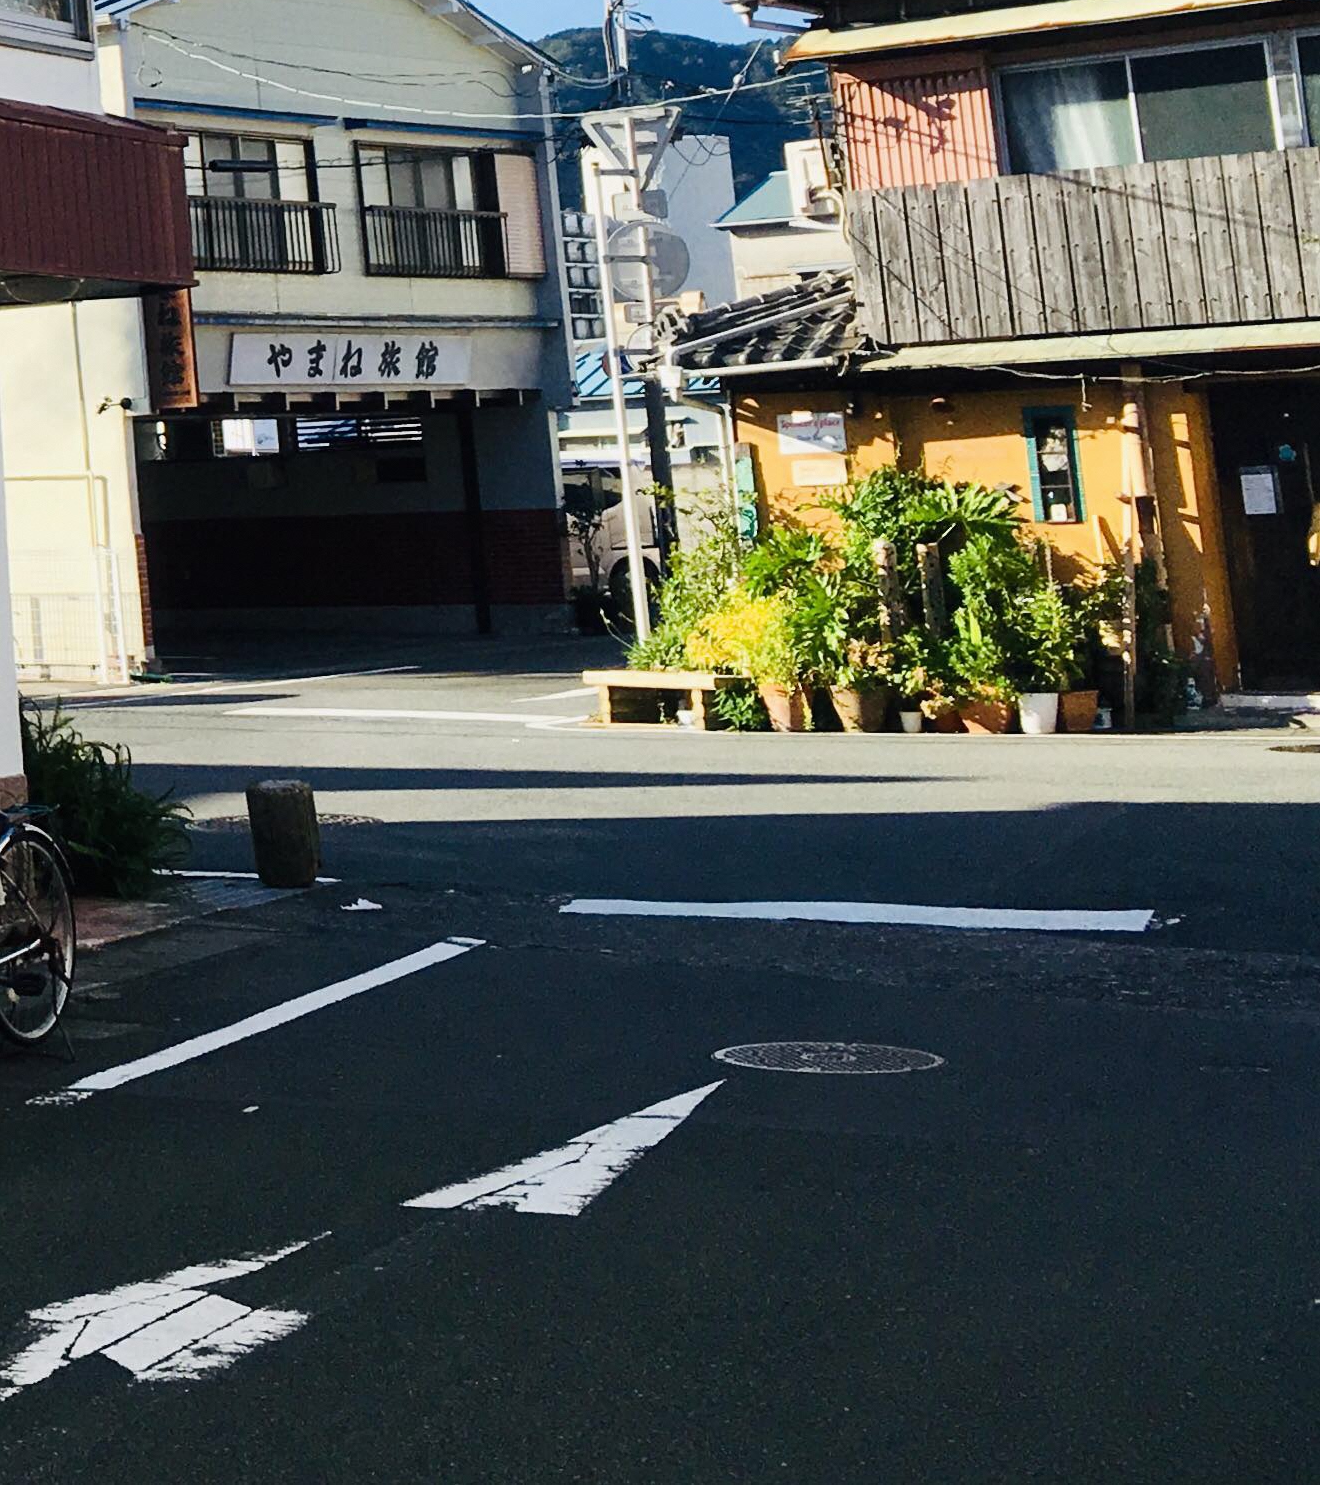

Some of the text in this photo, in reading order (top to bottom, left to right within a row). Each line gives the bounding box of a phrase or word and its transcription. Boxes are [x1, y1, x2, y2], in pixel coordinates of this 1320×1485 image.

[266, 339, 440, 380] やまね旅館
